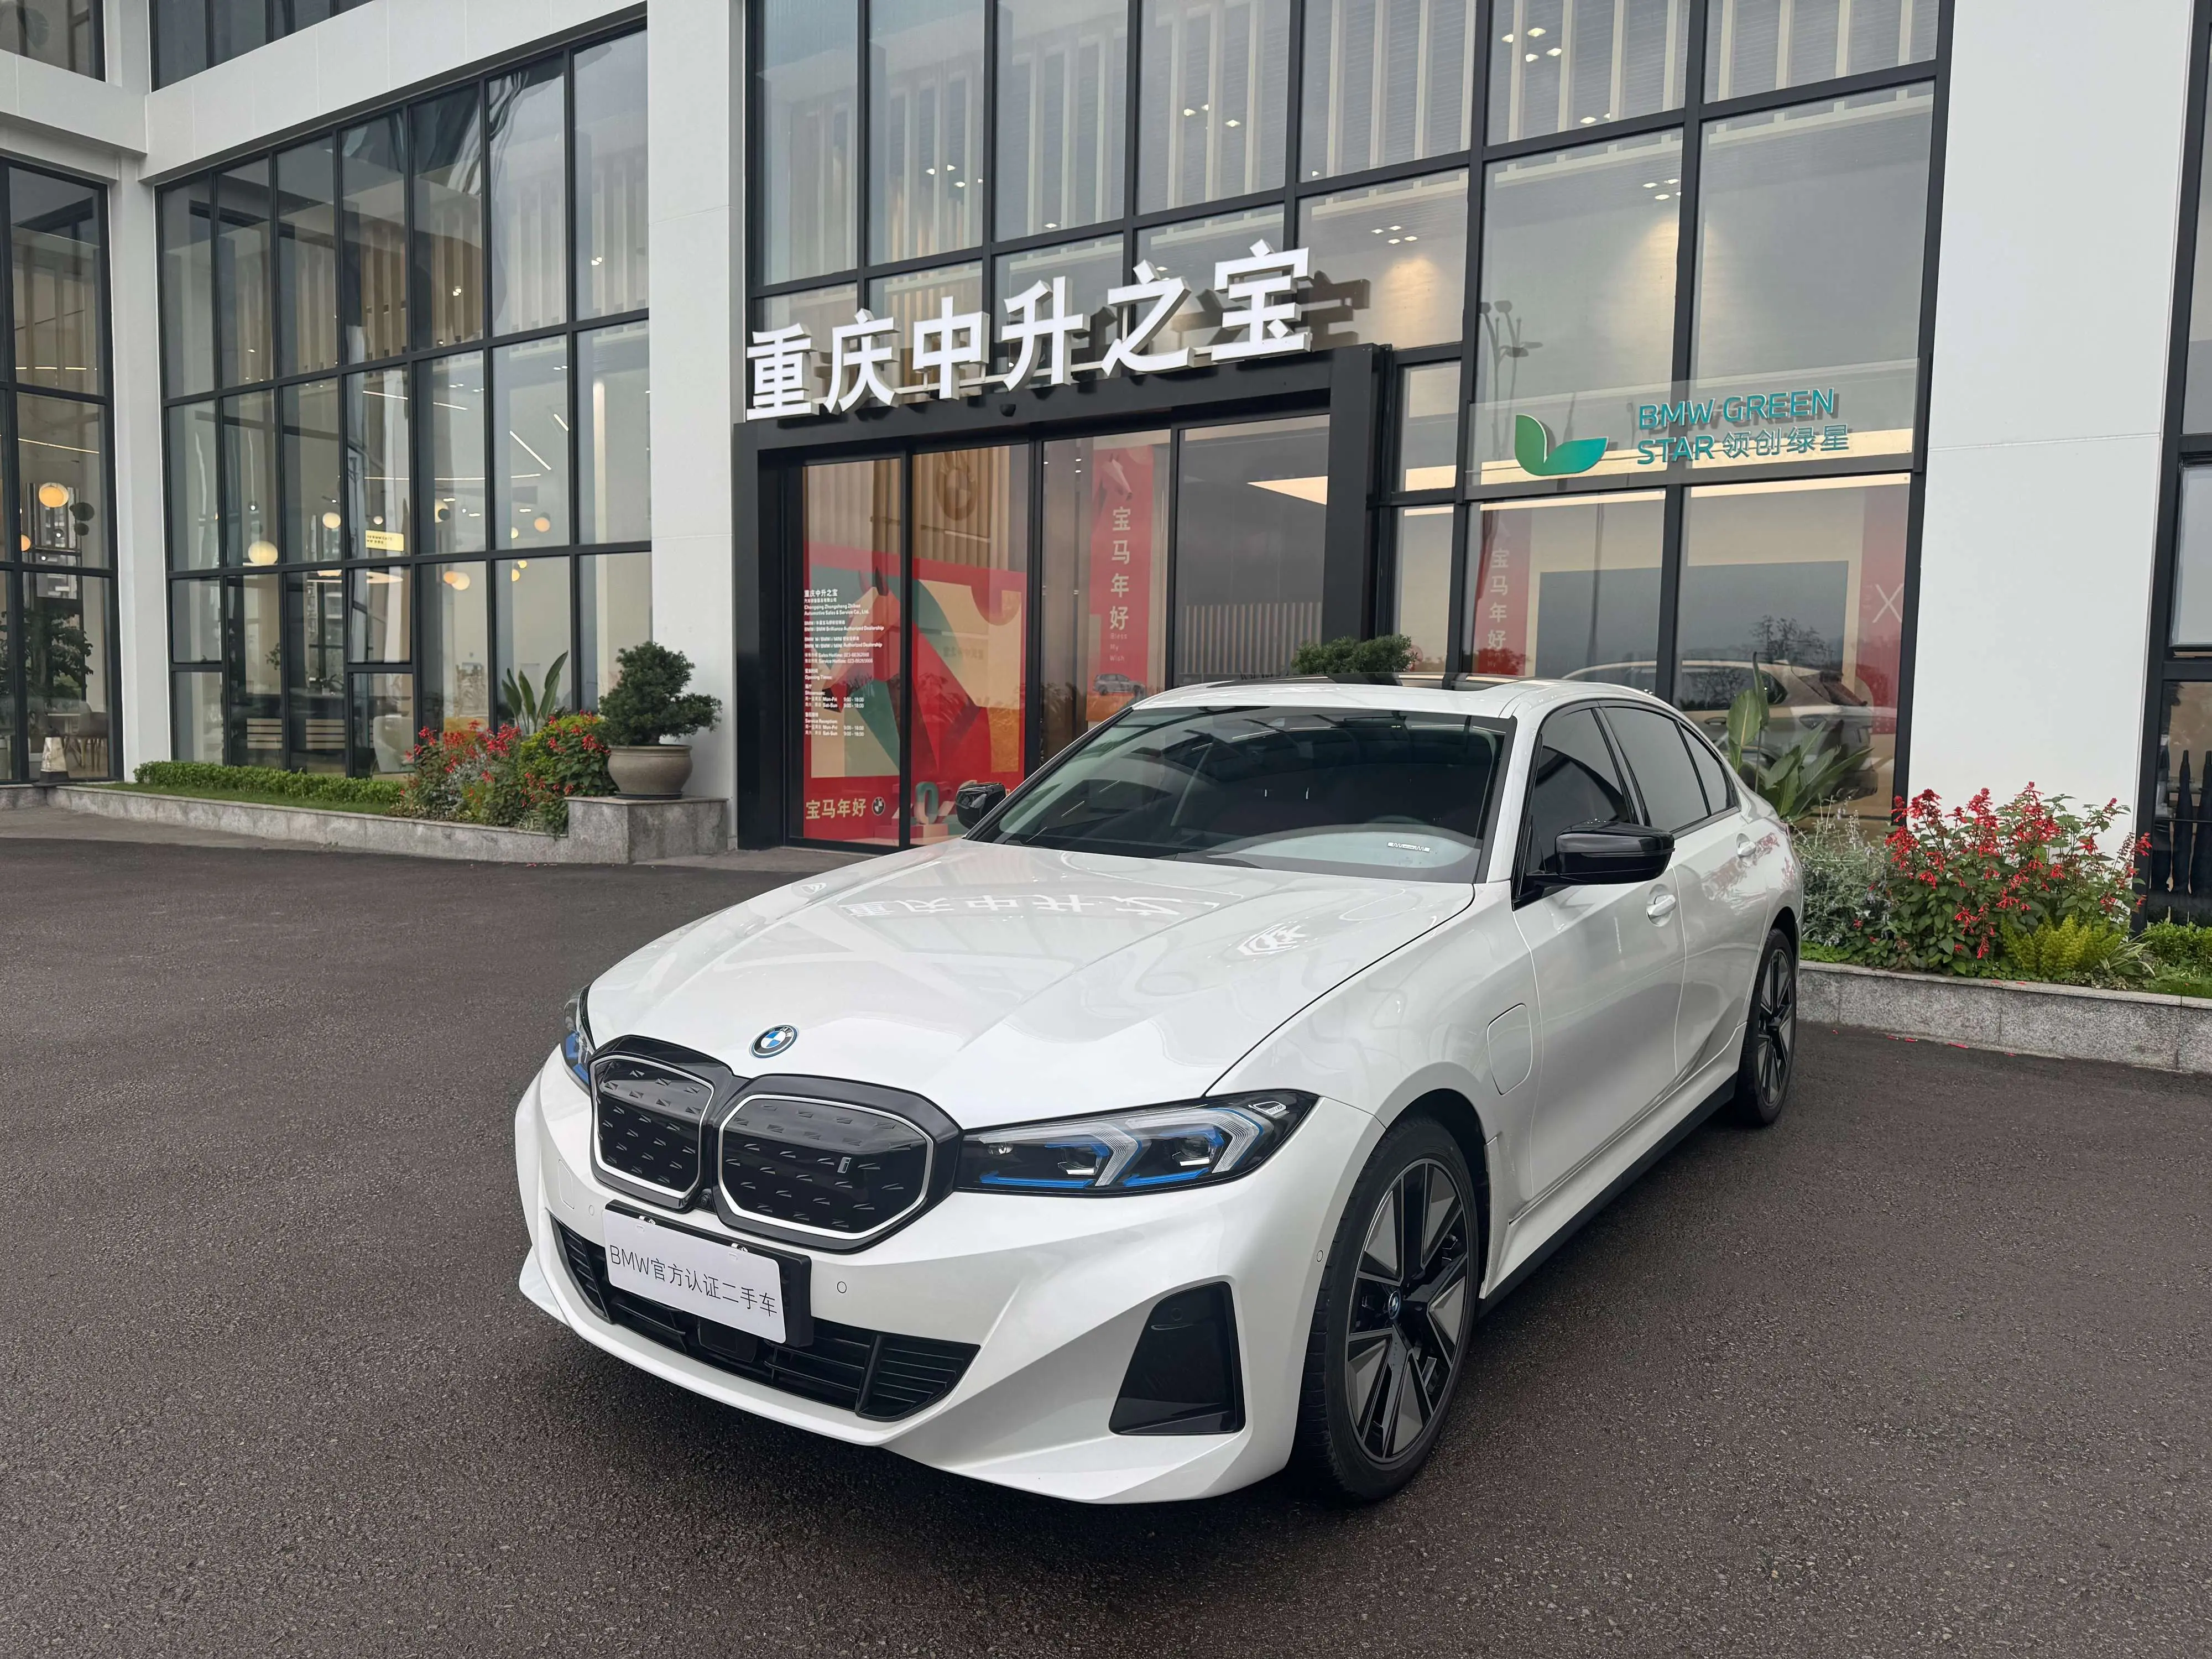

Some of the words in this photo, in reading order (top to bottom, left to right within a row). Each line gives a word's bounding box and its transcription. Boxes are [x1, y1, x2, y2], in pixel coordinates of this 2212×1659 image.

[746, 238, 1312, 421] 重庆中升之宝
[1637, 434, 1715, 465] STAR
[1723, 424, 1850, 459] 领创绿星
[1639, 398, 1715, 430] BMW
[1723, 388, 1835, 423] GREEN
[1109, 506, 1131, 630] 宝马年好
[1487, 547, 1510, 650] 宝马年好
[805, 798, 867, 820] 宝马年好
[610, 1245, 778, 1317] BMW官方认证二手车
